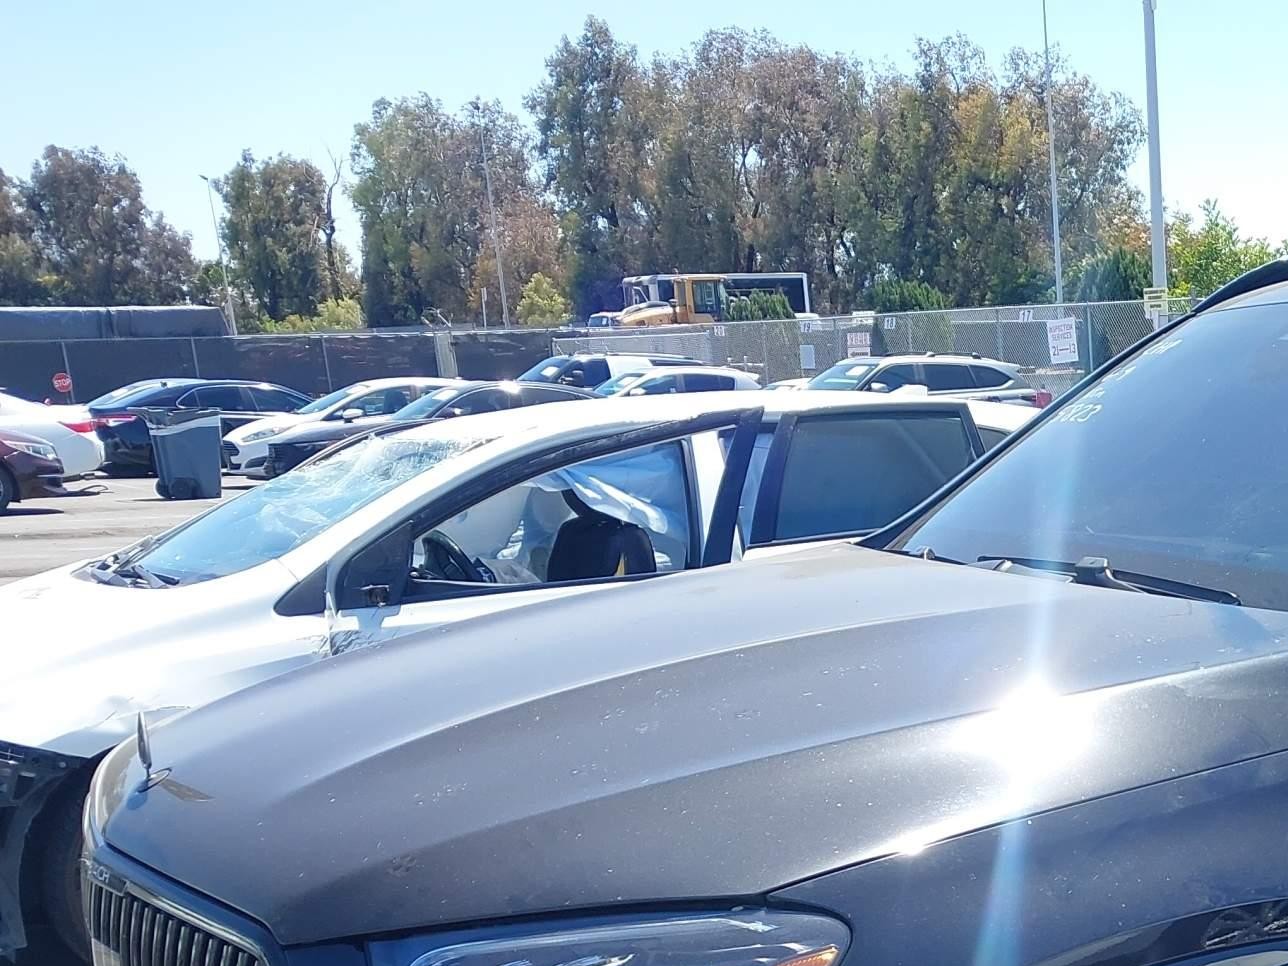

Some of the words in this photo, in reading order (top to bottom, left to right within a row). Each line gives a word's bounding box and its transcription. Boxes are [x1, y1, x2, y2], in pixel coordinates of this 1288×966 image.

[1022, 310, 1031, 322] 17
[803, 322, 811, 332] 19
[53, 378, 72, 388] STOP
